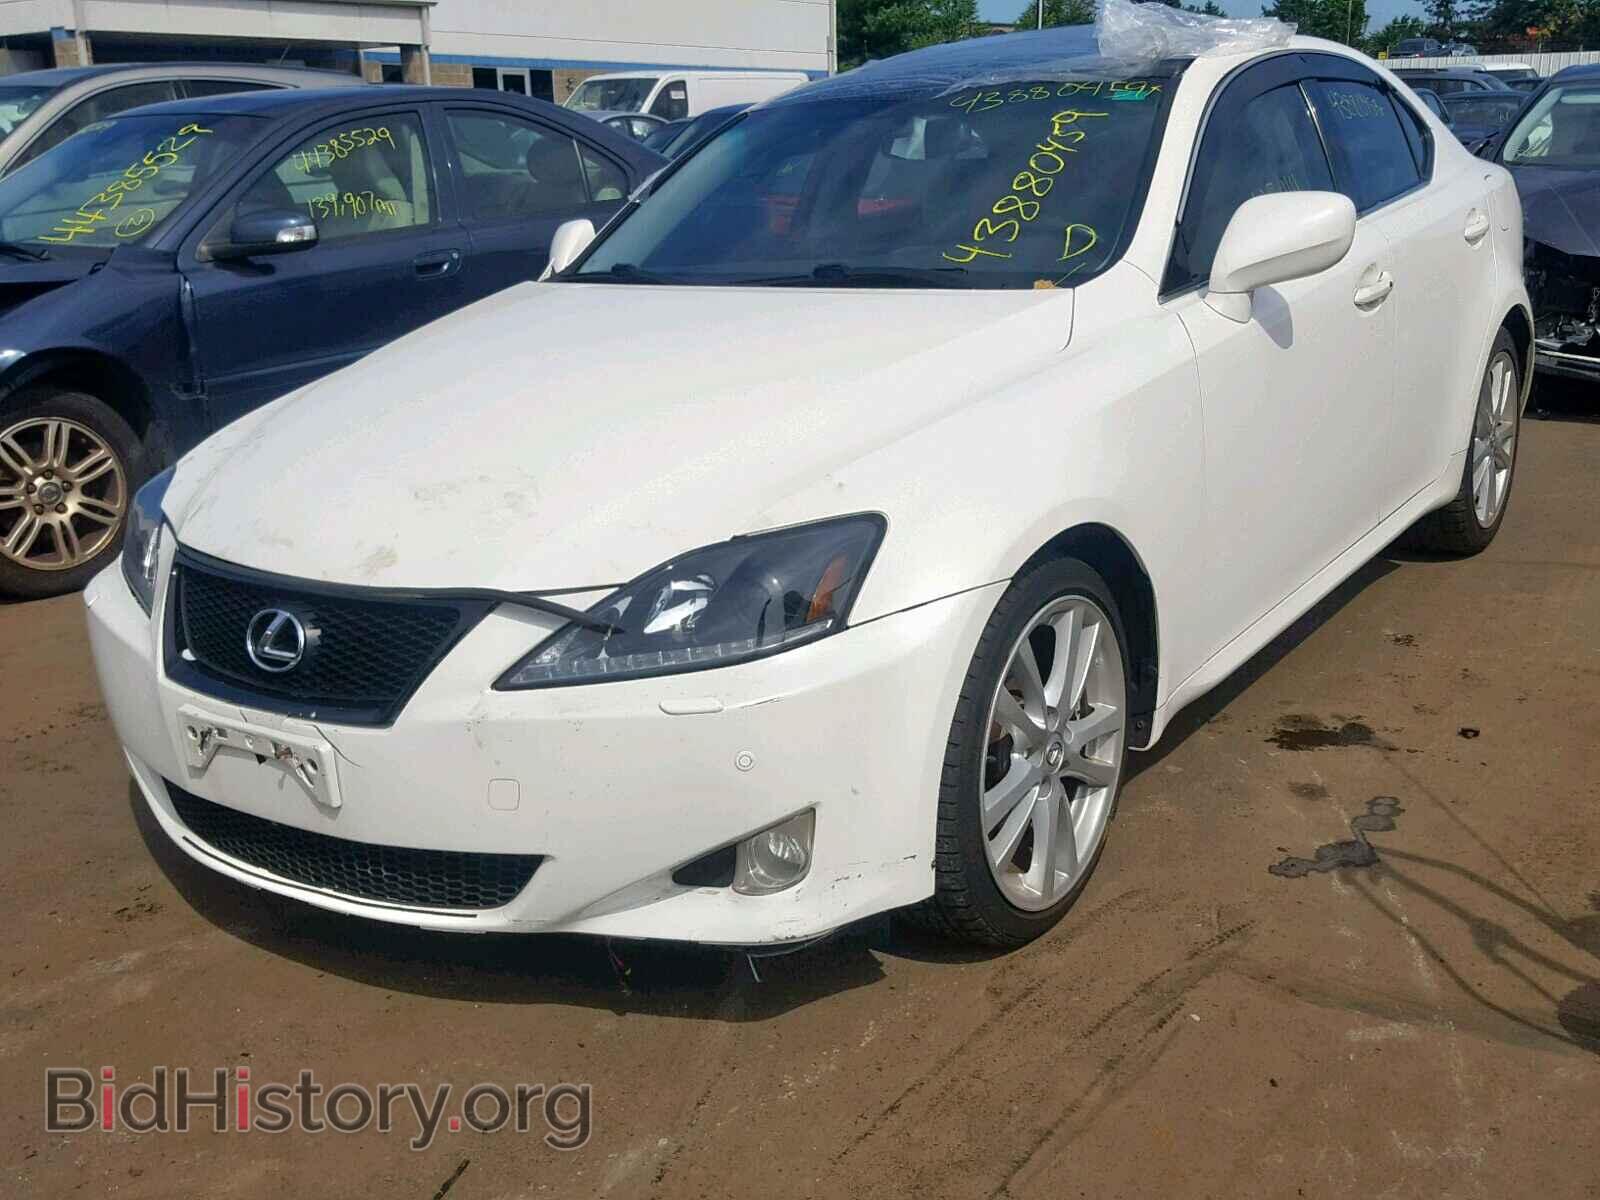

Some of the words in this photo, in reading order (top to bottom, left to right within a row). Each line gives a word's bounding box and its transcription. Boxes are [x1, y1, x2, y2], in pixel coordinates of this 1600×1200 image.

[37, 122, 214, 242] 44385529
[294, 127, 396, 174] 44385529
[942, 109, 1109, 263] 43880459
[1055, 223, 1098, 261] D
